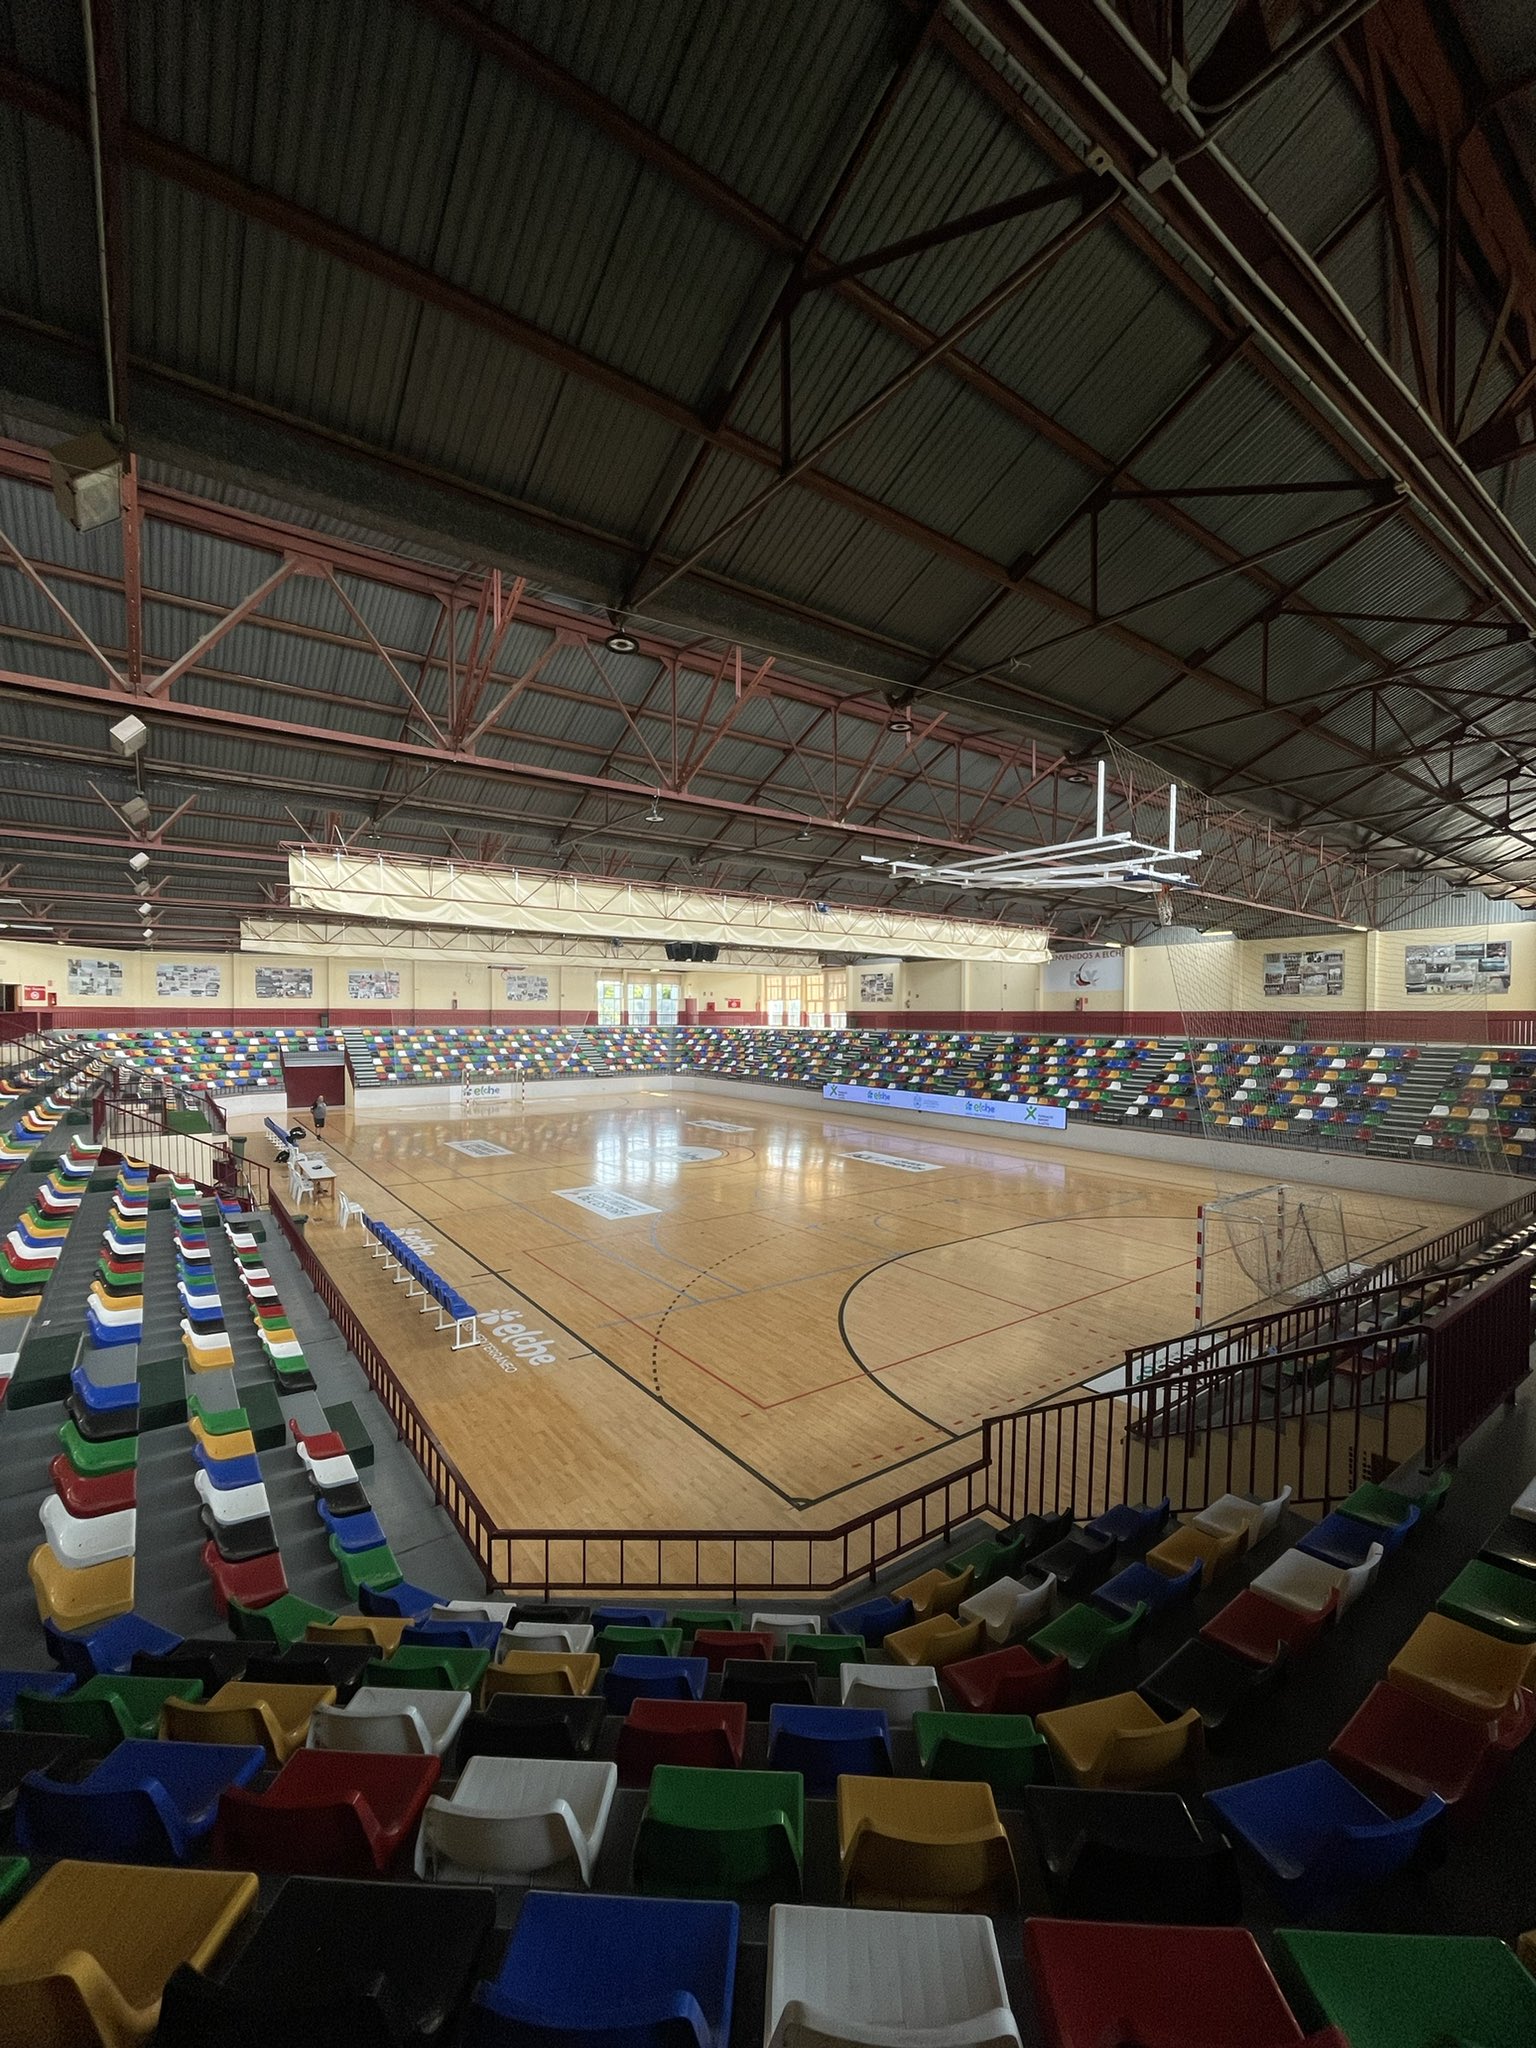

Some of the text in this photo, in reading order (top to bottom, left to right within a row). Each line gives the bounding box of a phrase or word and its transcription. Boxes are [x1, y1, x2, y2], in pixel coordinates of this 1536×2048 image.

[1051, 952, 1092, 960] ENVENIDOS
[1103, 950, 1125, 959] ELCHE
[474, 1086, 500, 1096] elche
[973, 1101, 995, 1113] elche
[492, 1323, 556, 1366] elche
